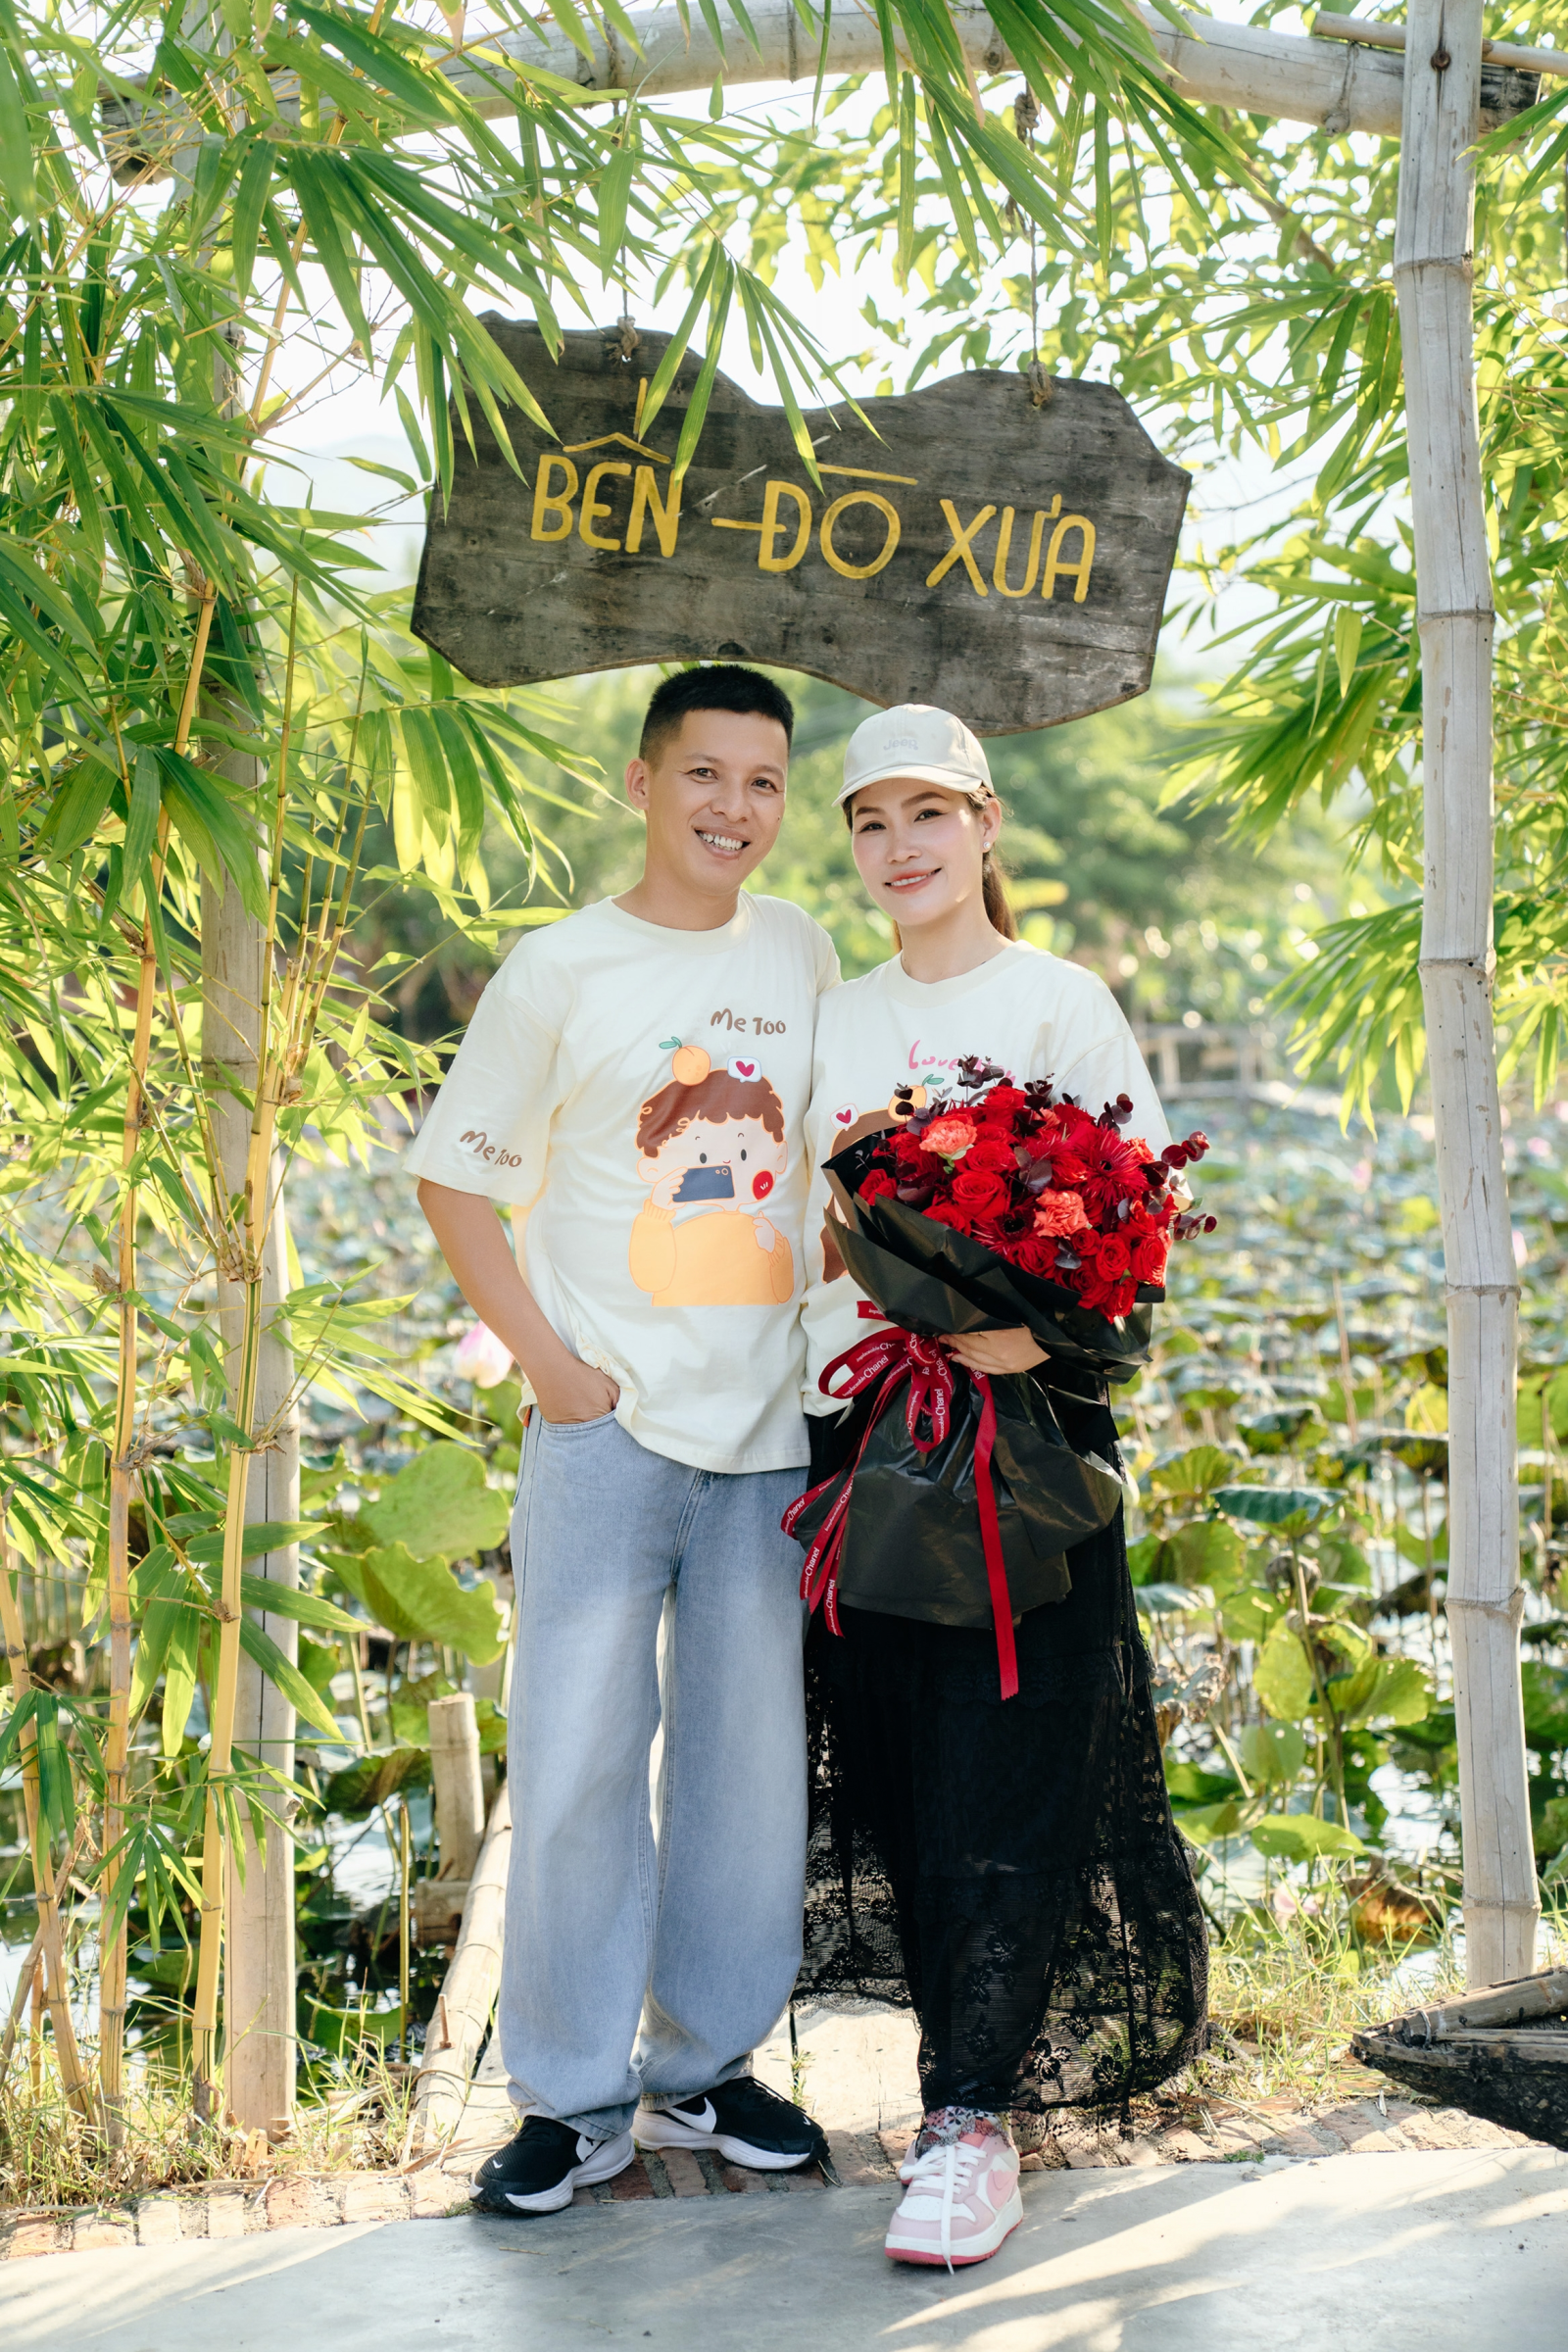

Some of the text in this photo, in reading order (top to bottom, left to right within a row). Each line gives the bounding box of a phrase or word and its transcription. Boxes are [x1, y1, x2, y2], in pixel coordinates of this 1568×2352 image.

[530, 377, 684, 558] BẾN
[926, 493, 1096, 604] XƯA
[883, 738, 919, 751] Jeep
[710, 1007, 786, 1036] Me Too
[460, 1130, 522, 1167] Me Too
[863, 1354, 889, 1379] Chanel
[934, 1388, 946, 1416] Chanel
[805, 1546, 820, 1577] Chanel
[825, 1579, 836, 1609] Chanel
